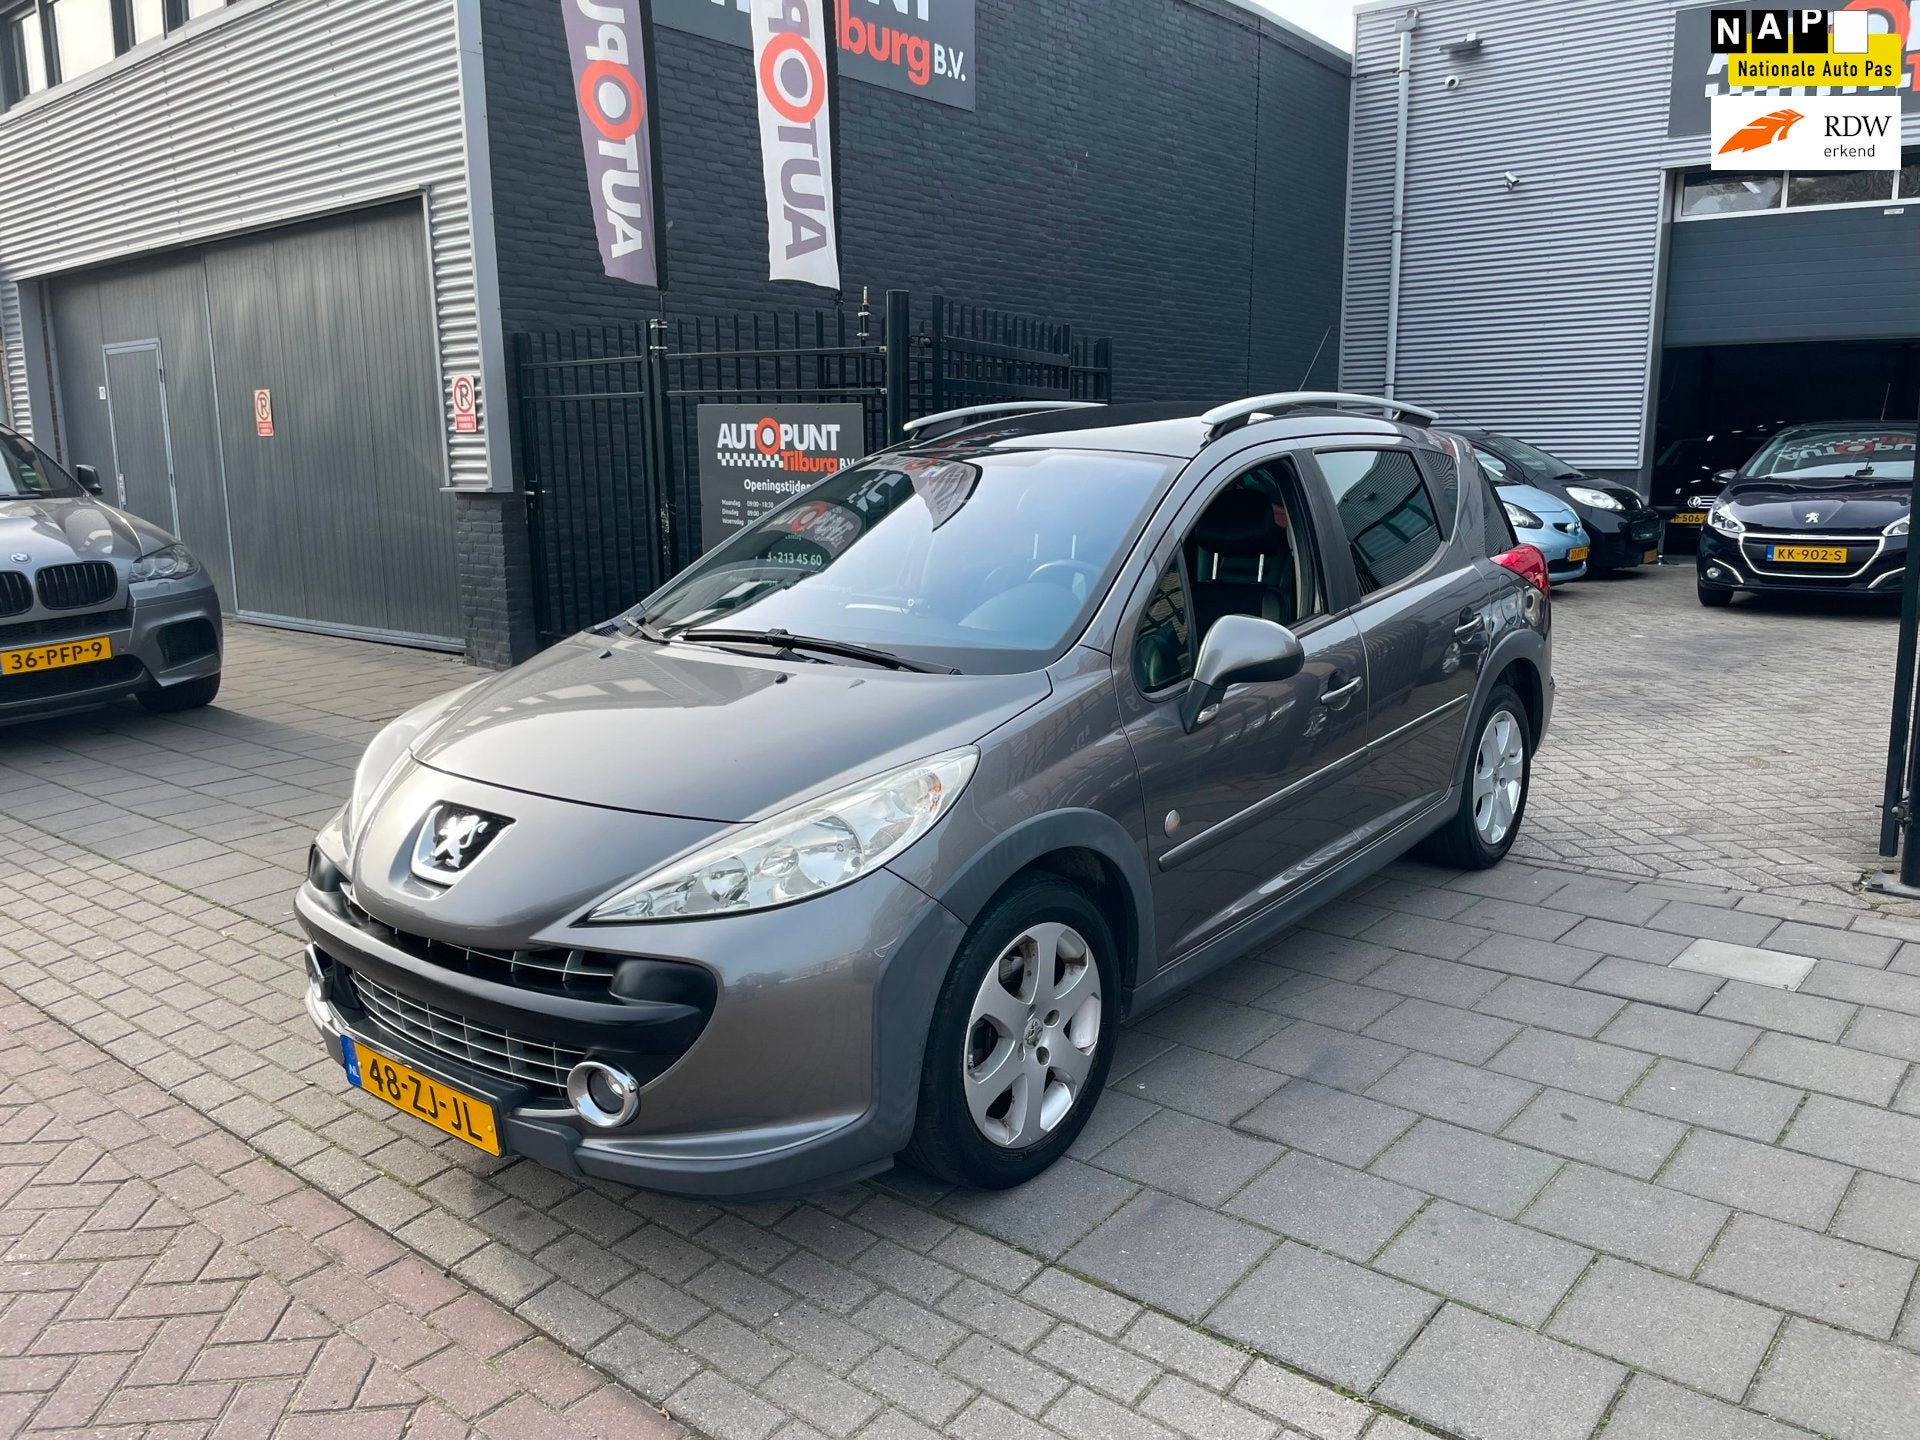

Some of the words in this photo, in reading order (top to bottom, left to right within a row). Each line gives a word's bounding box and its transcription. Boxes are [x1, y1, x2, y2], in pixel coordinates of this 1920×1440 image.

[834, 0, 930, 86] burg
[934, 43, 966, 82] B.V.
[717, 417, 840, 455] AUTOPUNT
[781, 450, 838, 476] Tilburg
[840, 457, 856, 471] BV
[811, 555, 822, 566] 60
[1778, 548, 1842, 561] KK-902-S
[11, 641, 102, 670] 36-PFP-9
[349, 1063, 359, 1077] NL
[369, 1058, 482, 1142] 48-ZJ-JL
